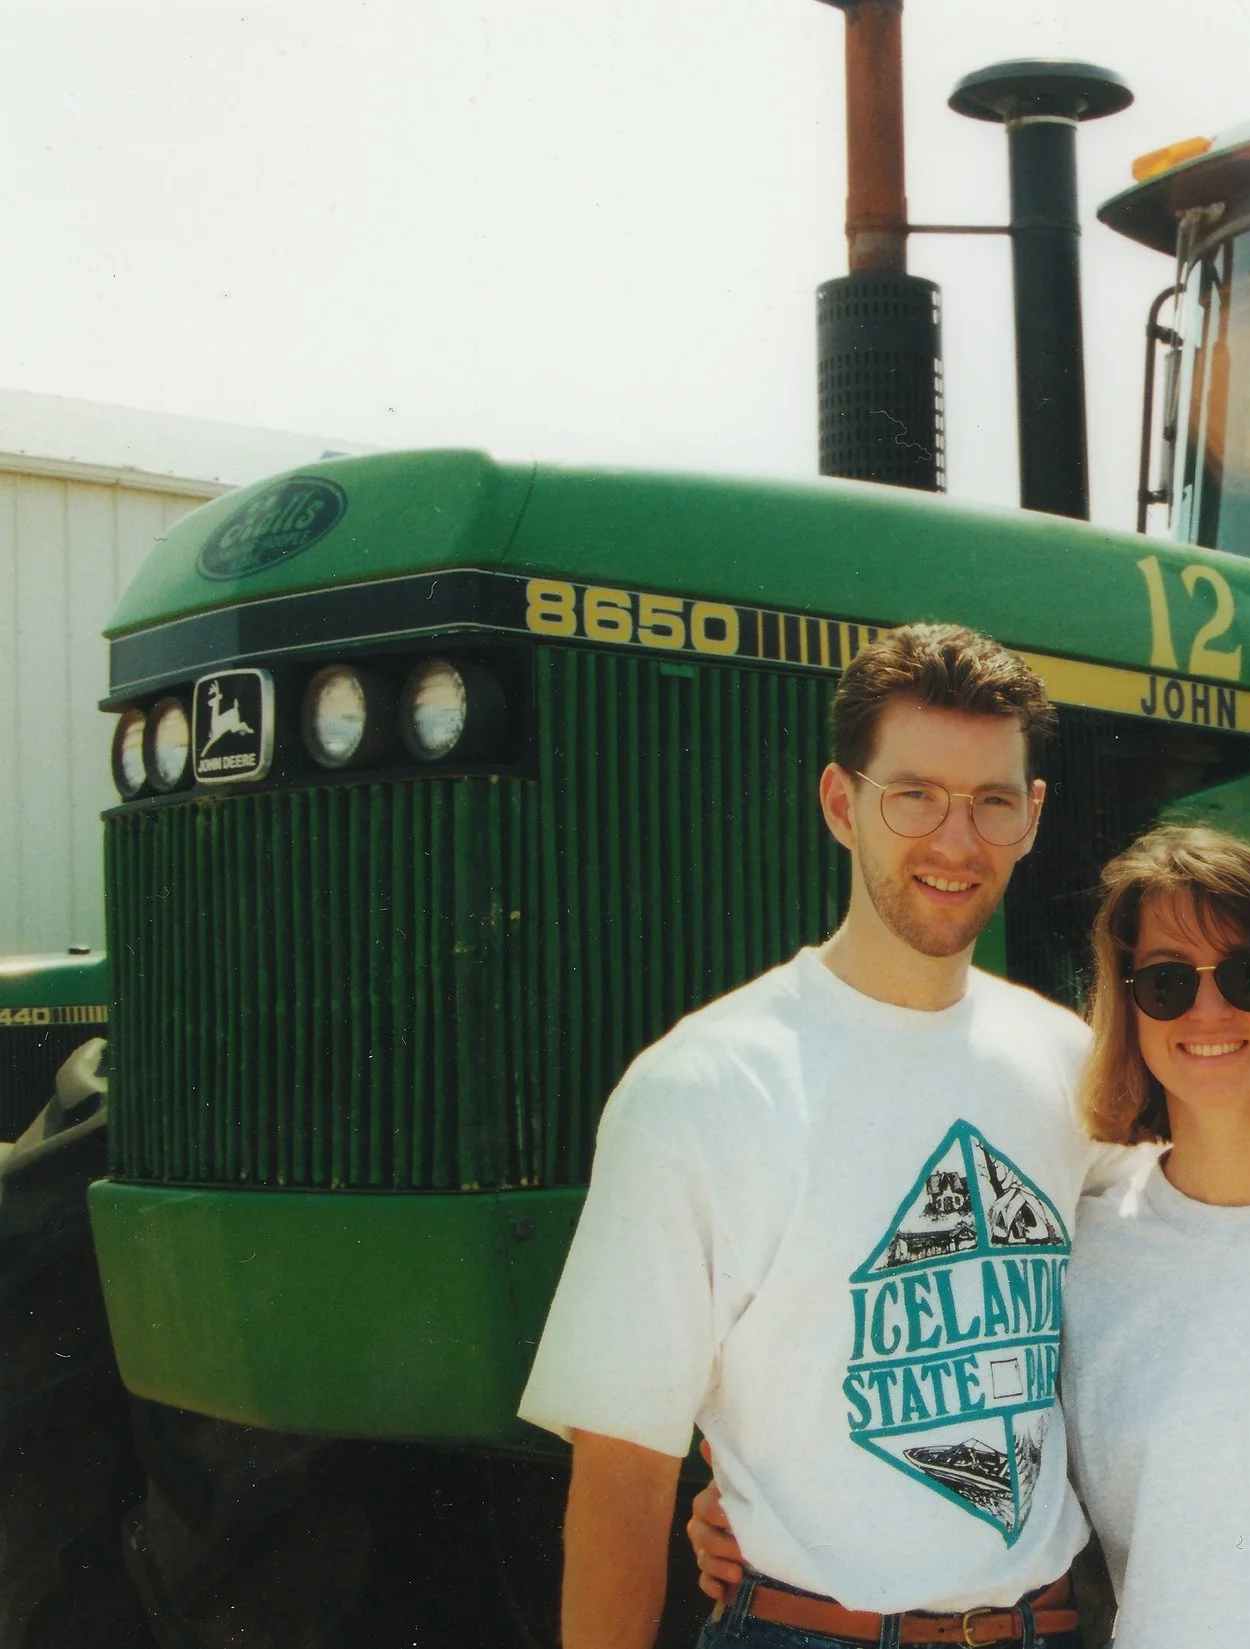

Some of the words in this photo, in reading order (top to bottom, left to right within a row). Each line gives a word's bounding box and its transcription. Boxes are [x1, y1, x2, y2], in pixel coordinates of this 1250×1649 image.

[526, 578, 740, 656] 8650
[1137, 555, 1242, 681] 12
[1140, 675, 1236, 729] JOHN
[198, 757, 222, 773] JOHN
[222, 753, 257, 770] DEERE
[842, 1354, 986, 1431] STATE
[1024, 1343, 1060, 1401] PAR
